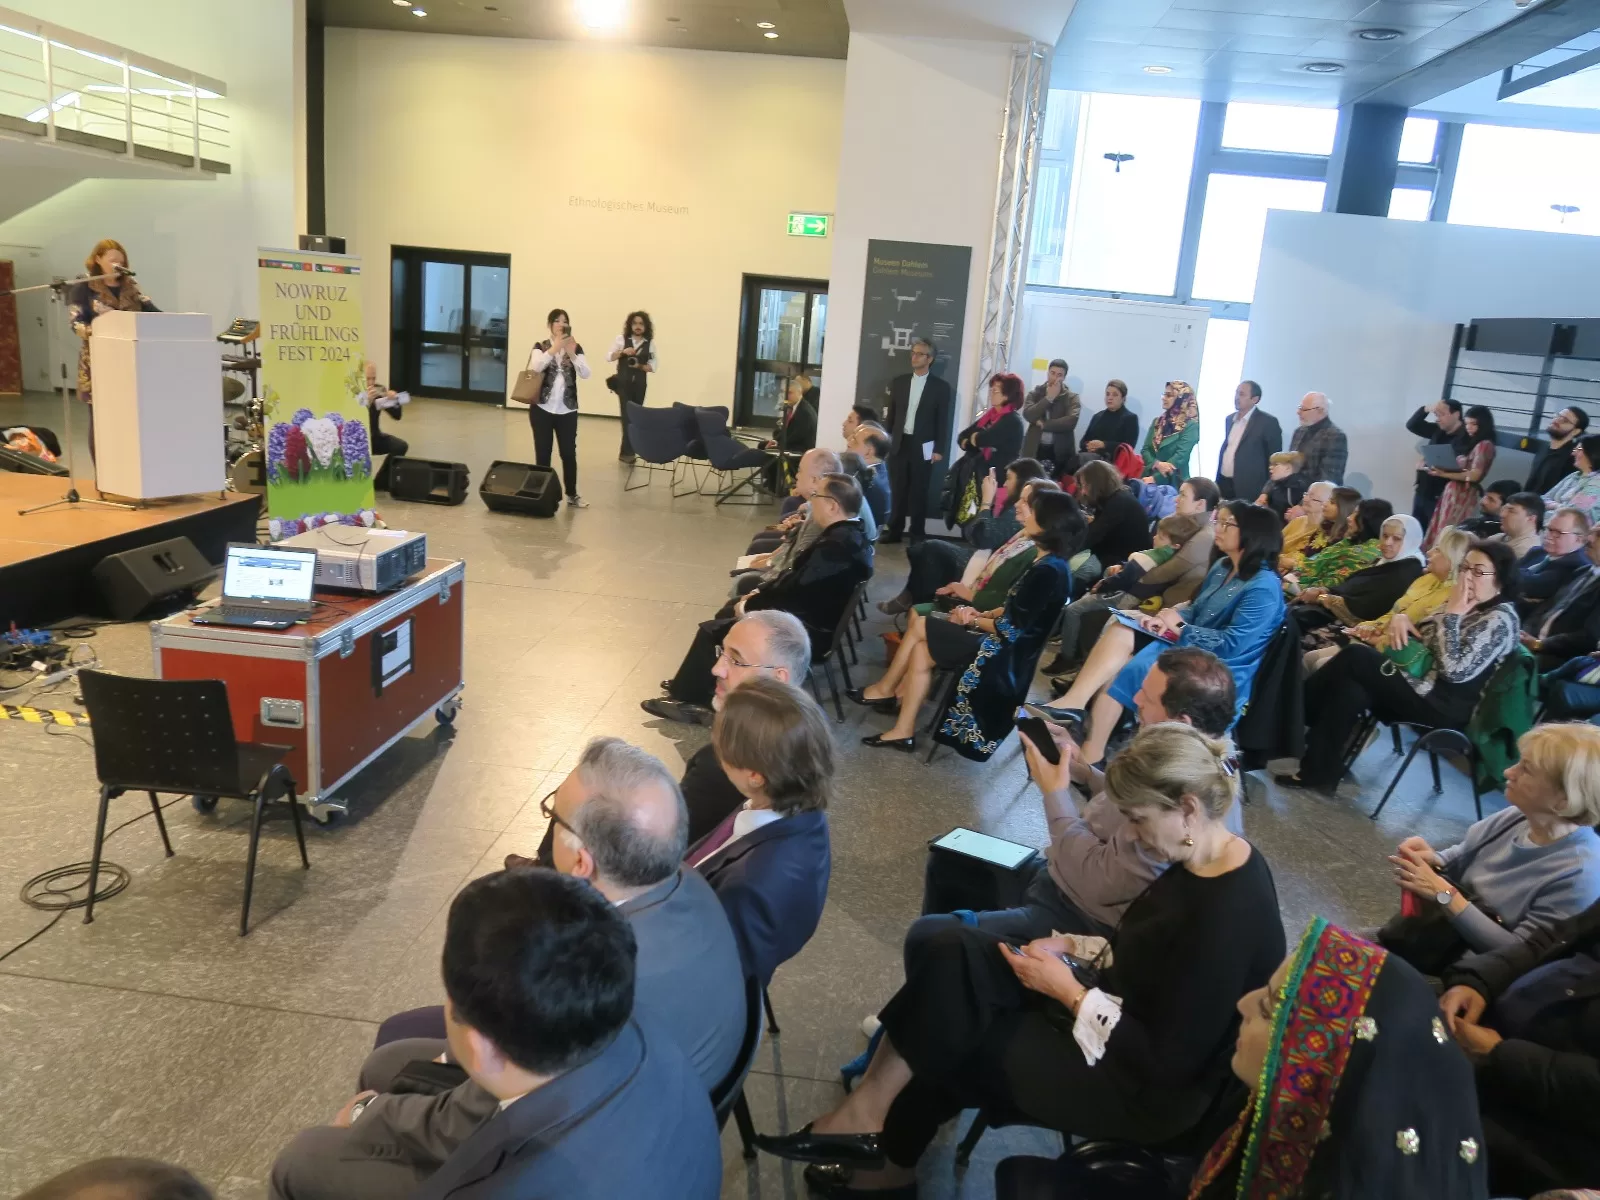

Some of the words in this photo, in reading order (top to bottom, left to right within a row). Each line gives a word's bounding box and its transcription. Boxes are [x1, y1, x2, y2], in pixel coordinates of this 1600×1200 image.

[568, 195, 644, 212] Ethnologisches
[647, 201, 689, 215] Museum
[275, 282, 348, 302] NOWRUZ
[295, 304, 331, 321] UND
[270, 322, 359, 342] FRÜHLINGS
[278, 345, 315, 361] FEST
[319, 346, 351, 362] 2024
